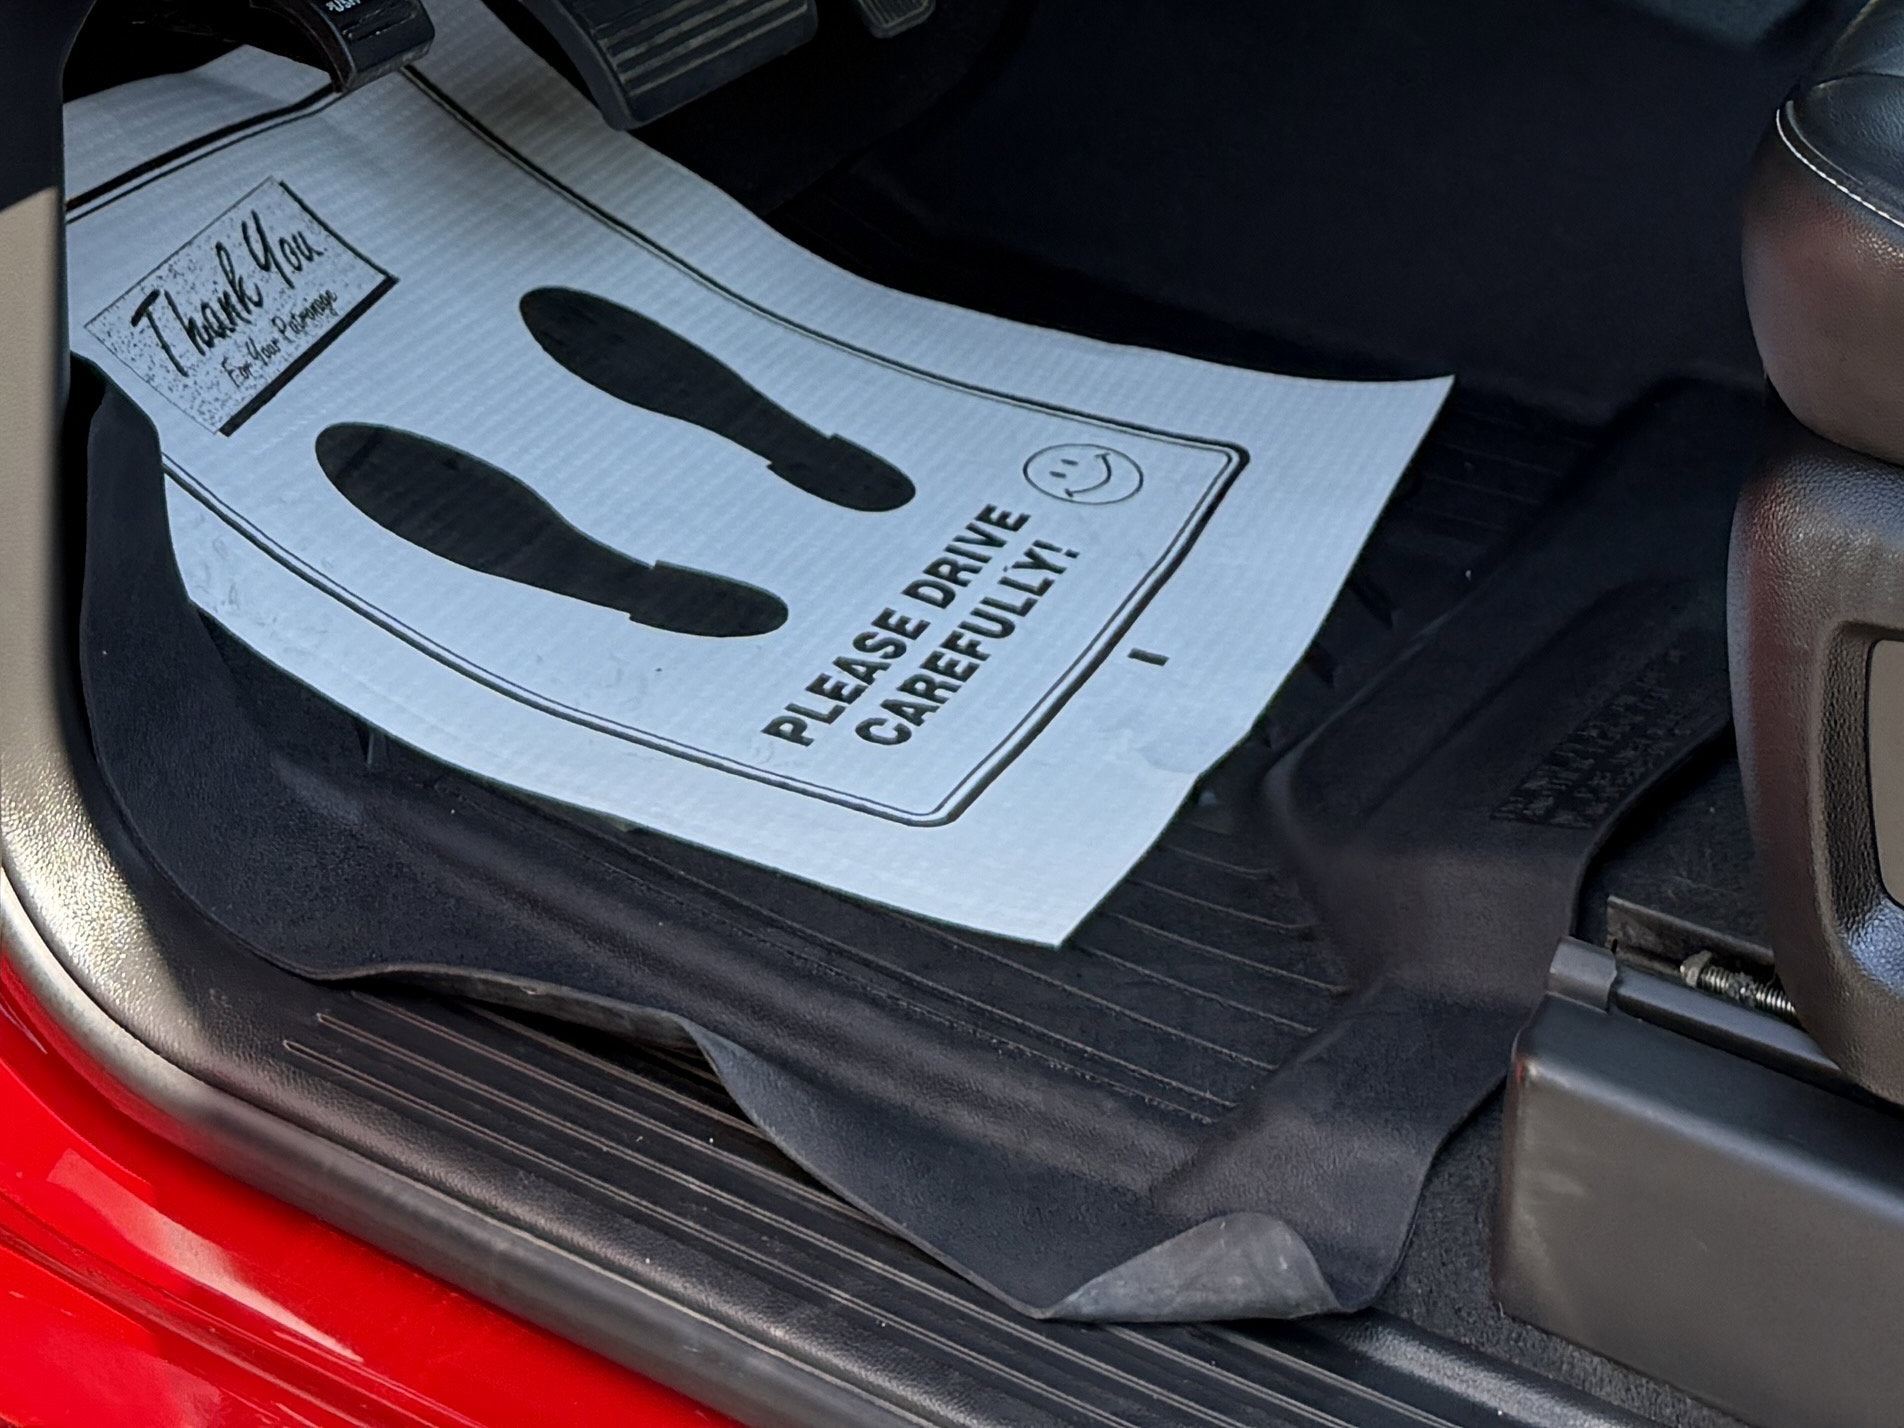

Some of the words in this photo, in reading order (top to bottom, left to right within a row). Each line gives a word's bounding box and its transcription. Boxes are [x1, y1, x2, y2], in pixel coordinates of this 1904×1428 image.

[130, 240, 264, 378] Thank
[241, 209, 325, 290] You
[221, 356, 255, 388] For
[245, 336, 281, 366] Your
[760, 607, 931, 747] PLEASE
[900, 503, 1031, 610] DRIVE
[854, 539, 1080, 746] CAREFULLY!
